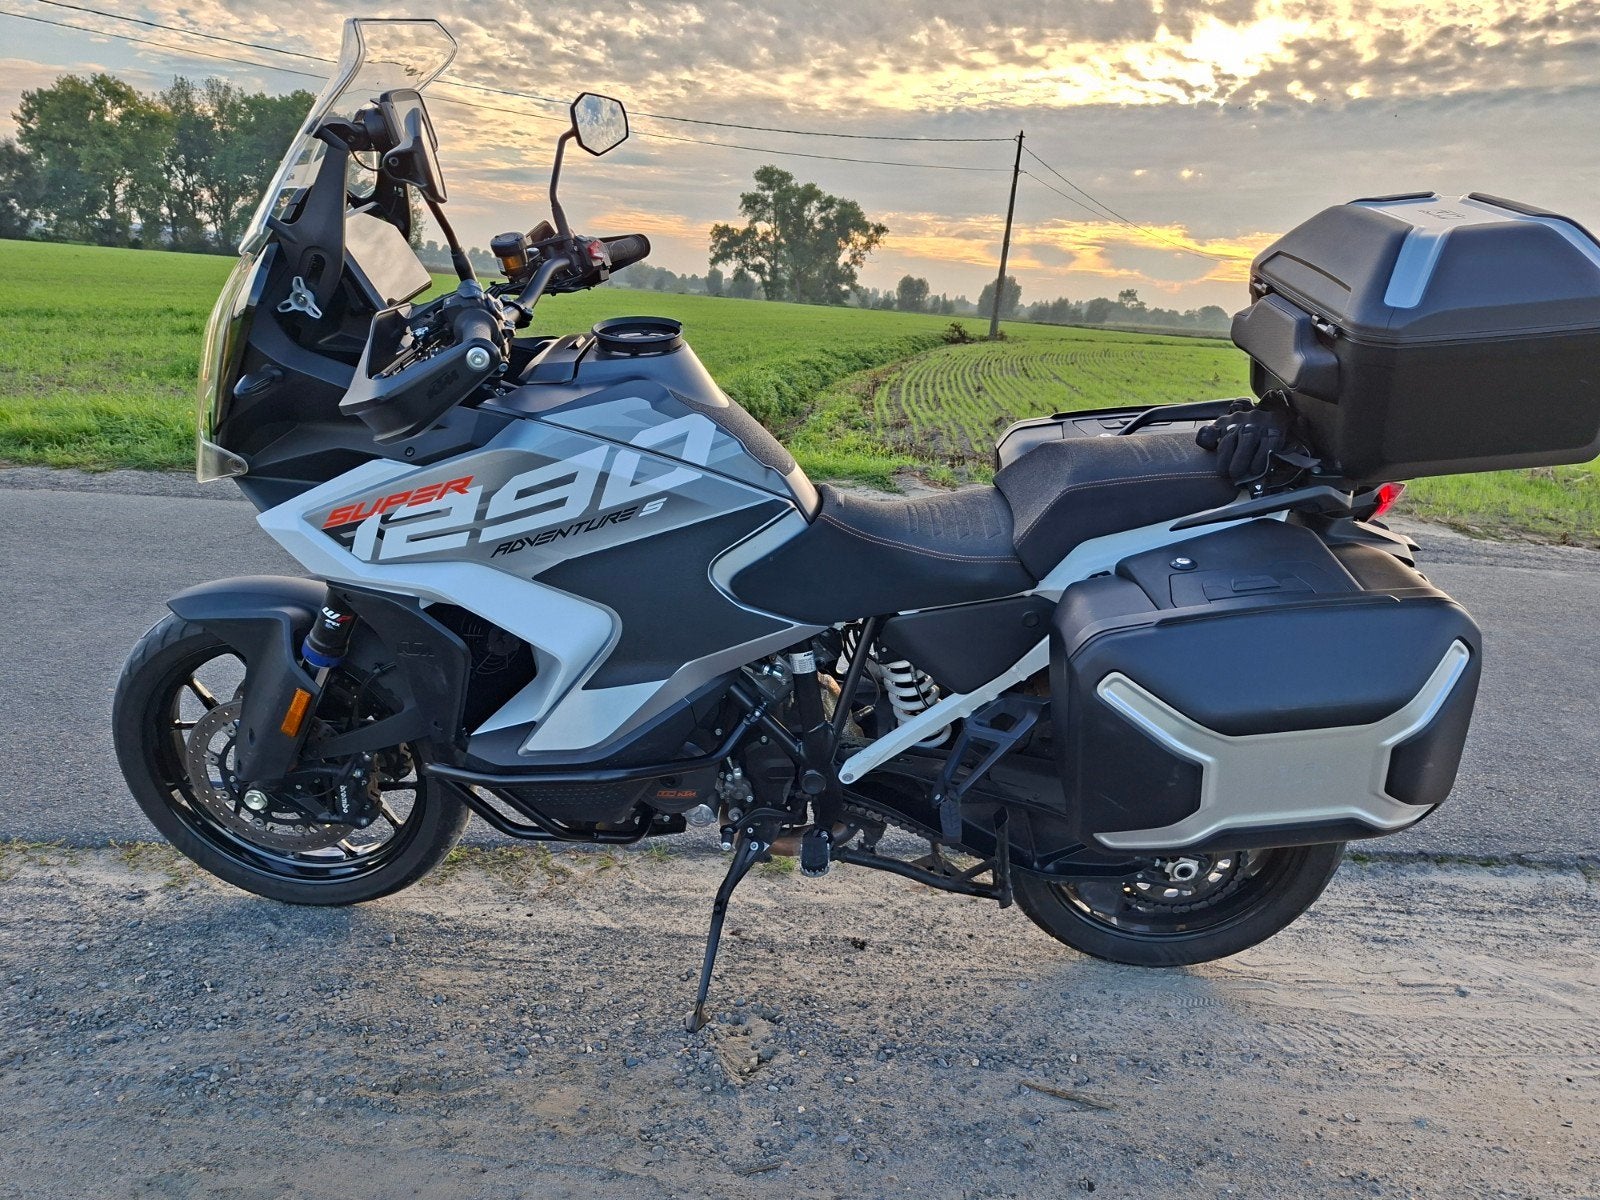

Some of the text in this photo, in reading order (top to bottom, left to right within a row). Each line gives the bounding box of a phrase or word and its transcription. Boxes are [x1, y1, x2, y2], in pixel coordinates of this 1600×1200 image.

[322, 475, 475, 529] SUPER
[351, 413, 717, 561] 1290
[490, 497, 668, 558] ADVENTURE S
[339, 784, 350, 814] brembo
